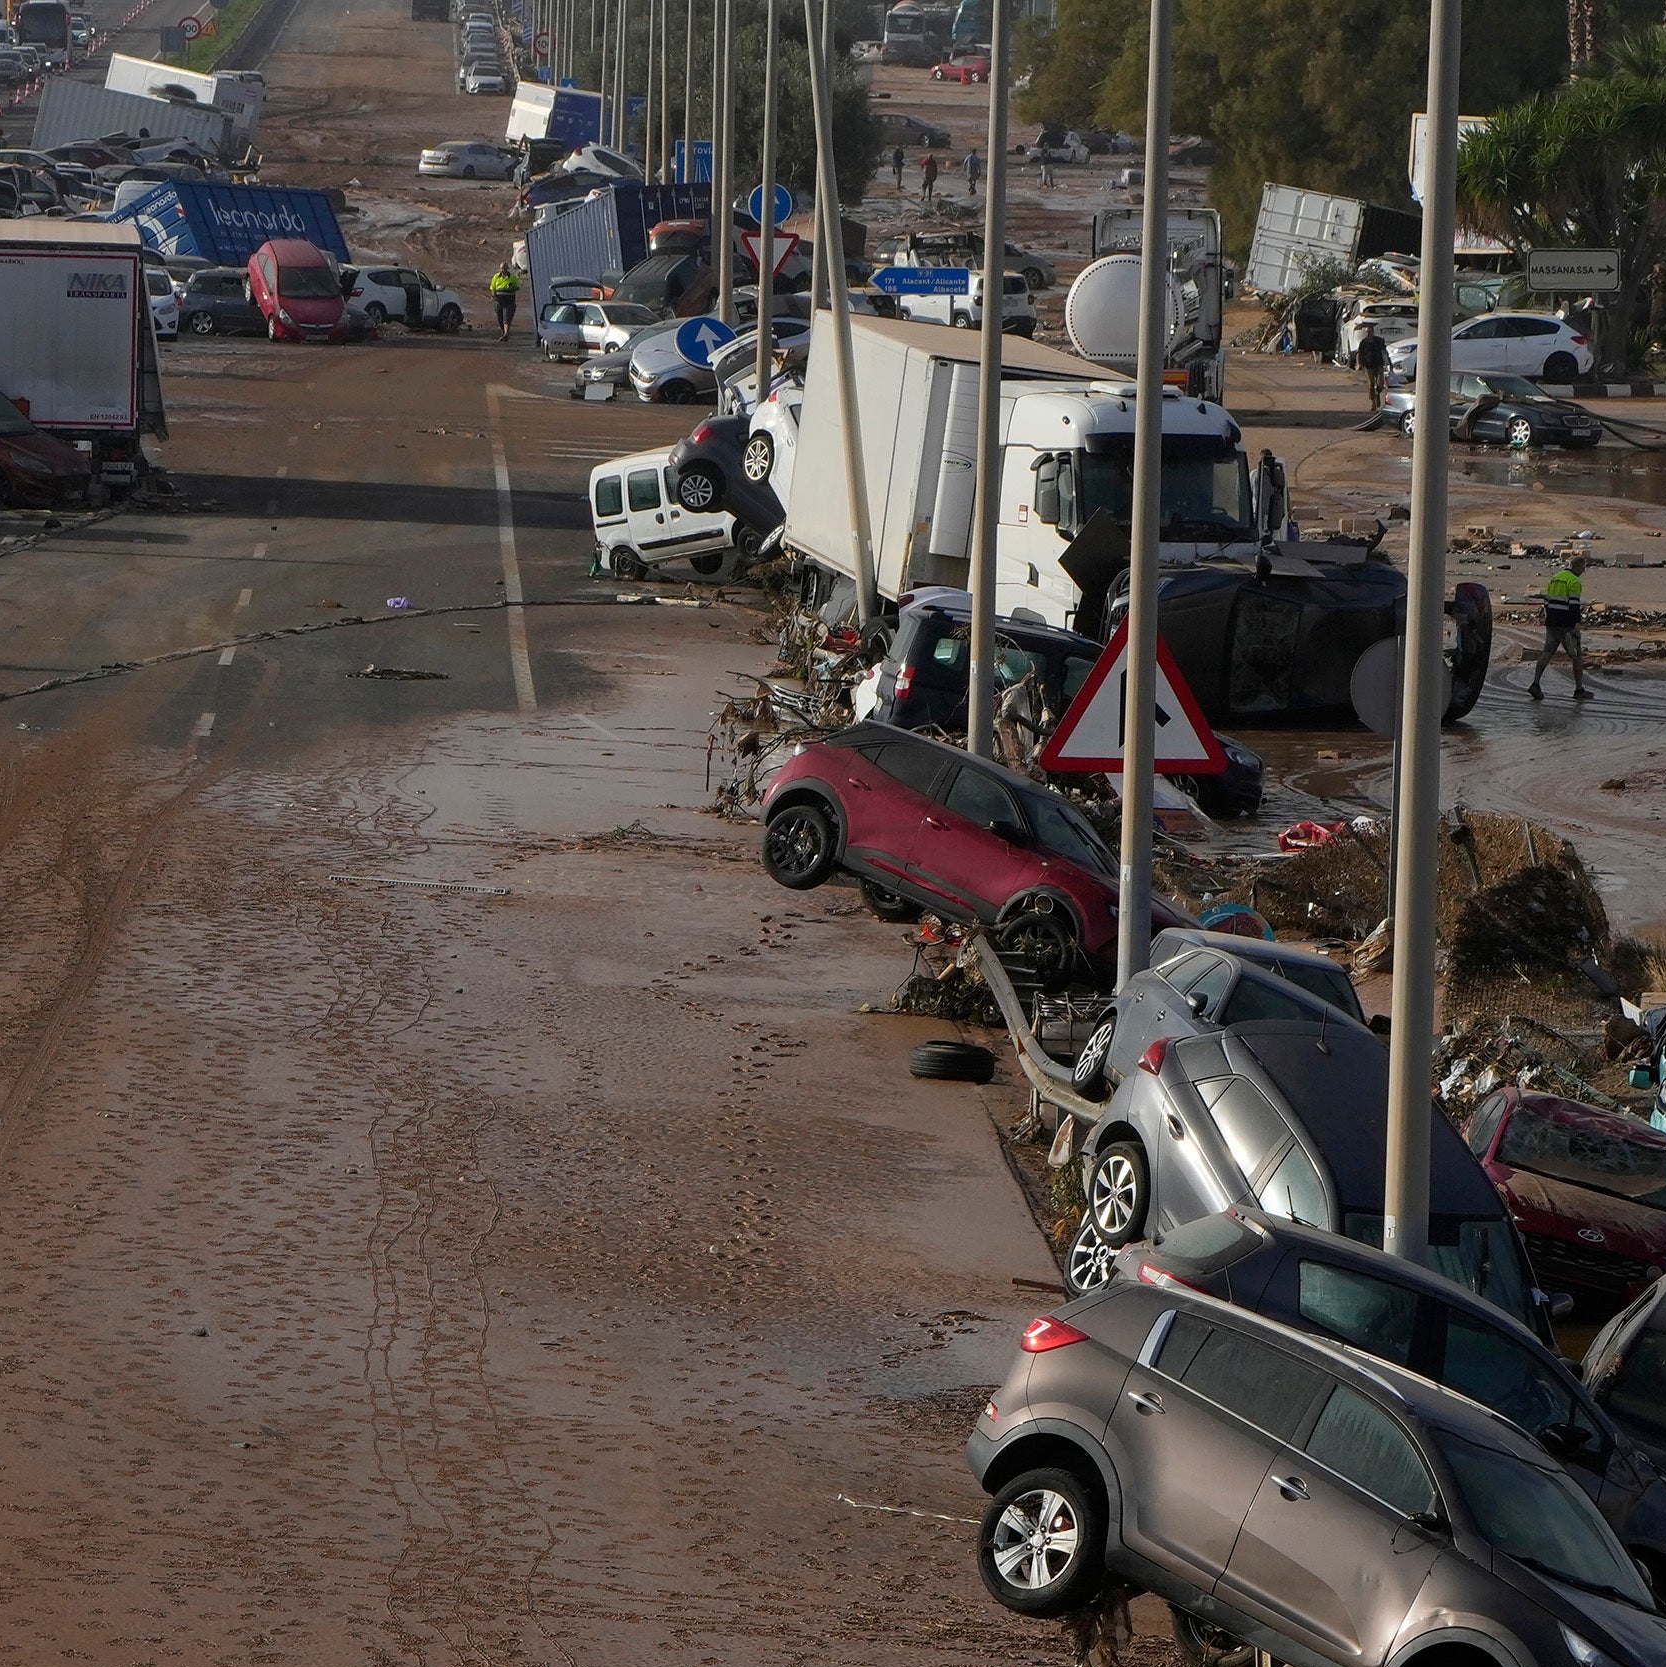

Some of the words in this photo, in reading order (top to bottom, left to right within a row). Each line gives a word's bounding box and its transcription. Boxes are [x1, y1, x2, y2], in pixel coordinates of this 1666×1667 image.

[208, 198, 305, 232] leonardo
[1531, 265, 1594, 275] MASSANASSA
[68, 273, 126, 290] NIKA
